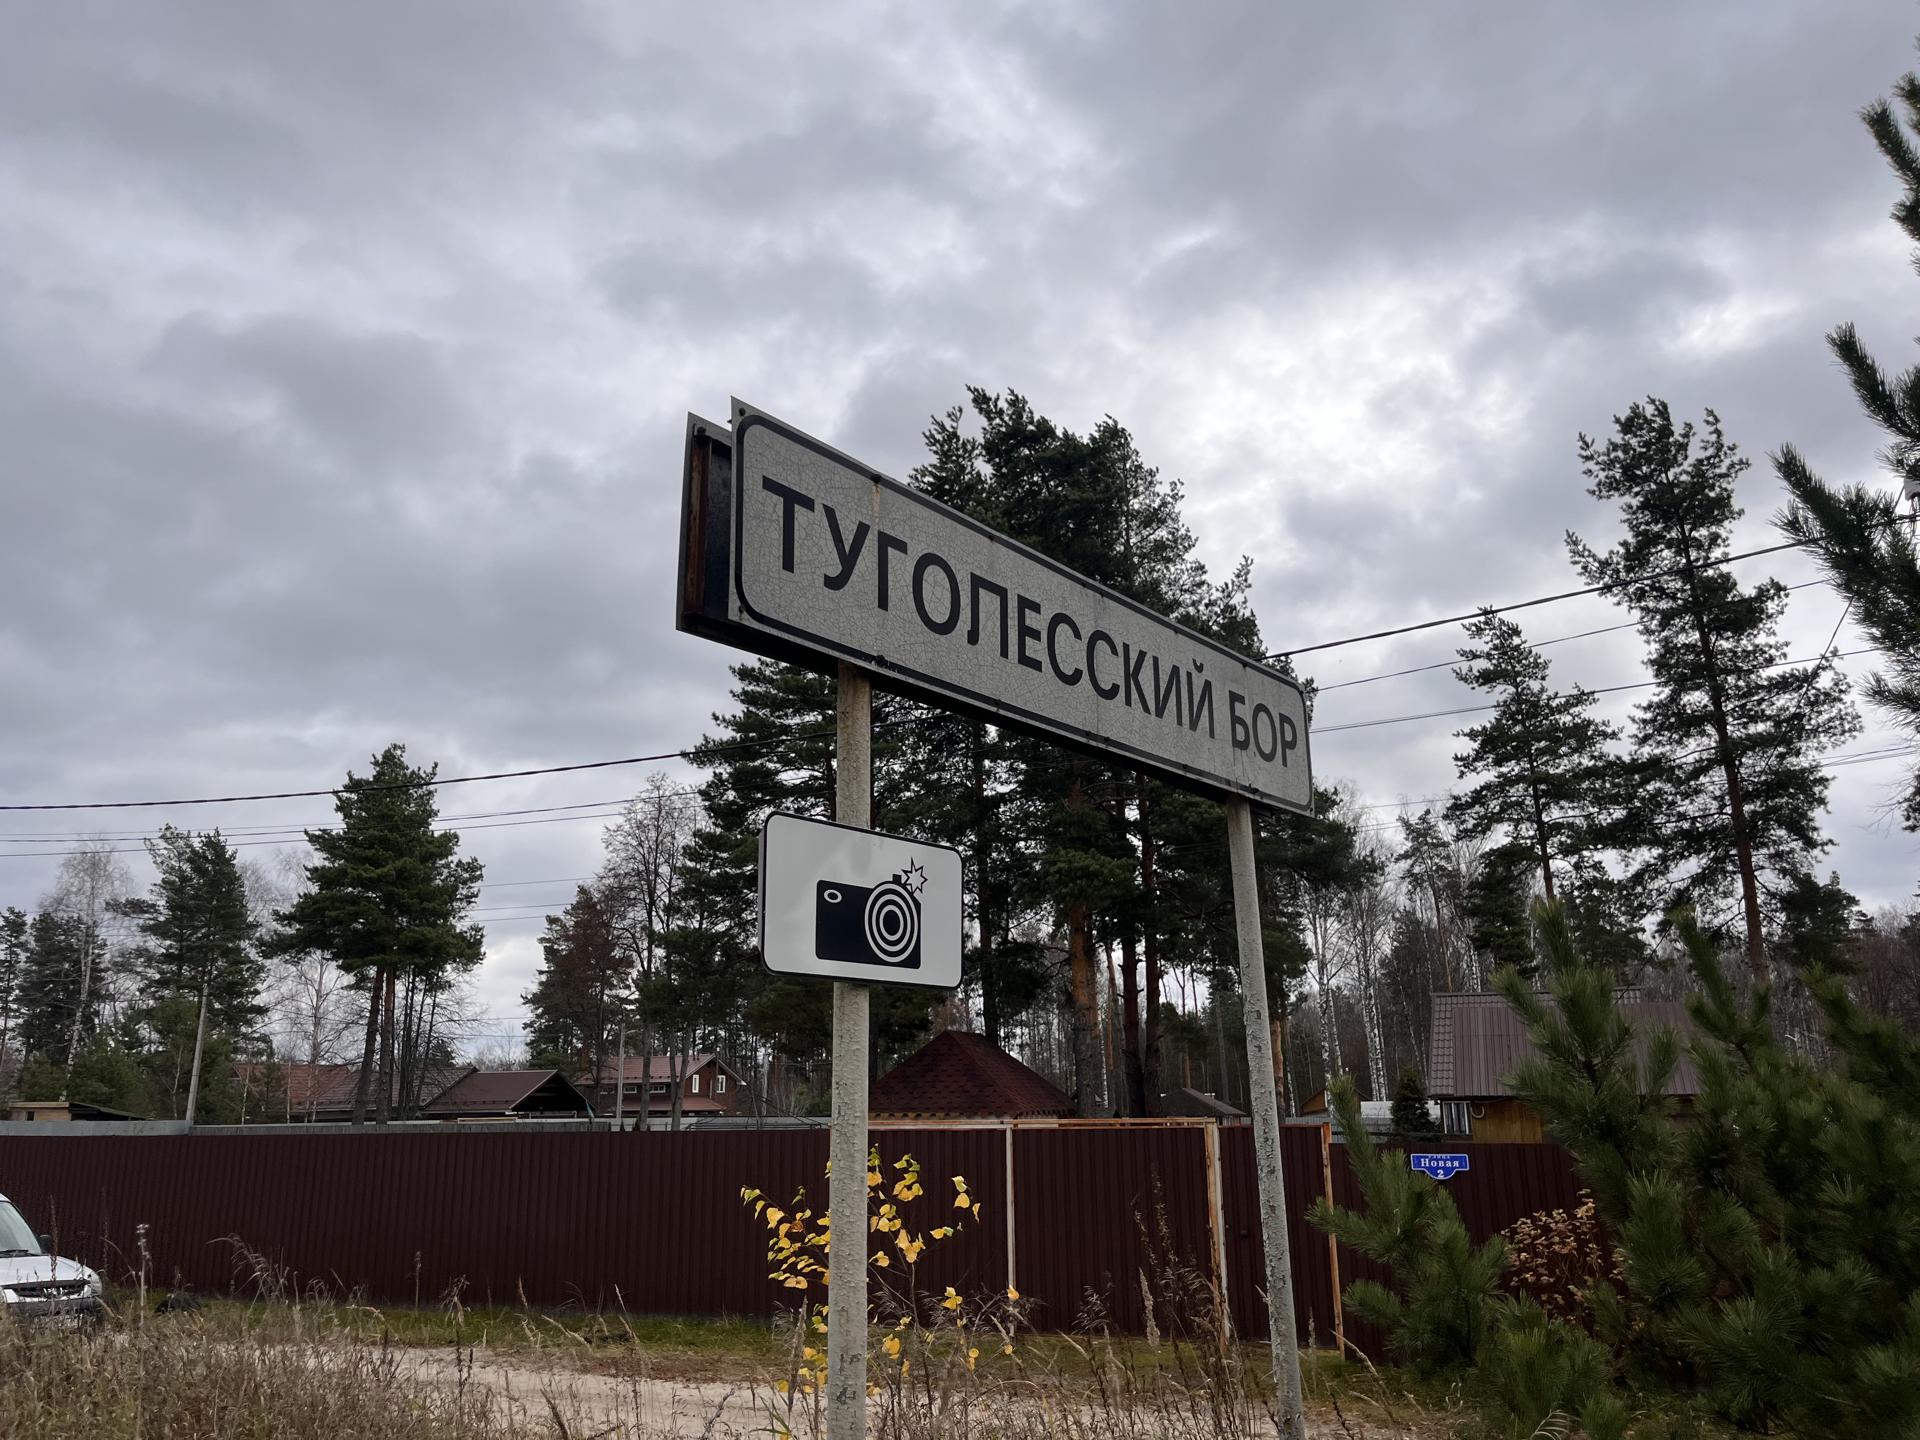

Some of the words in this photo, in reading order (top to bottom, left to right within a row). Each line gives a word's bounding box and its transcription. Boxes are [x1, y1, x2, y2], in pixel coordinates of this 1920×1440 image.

[762, 477, 1215, 739] ТУГОЛЕССКИЙ
[1229, 690, 1297, 766] БОР
[1421, 1158, 1460, 1167] Новая
[1437, 1169, 1444, 1178] 2
